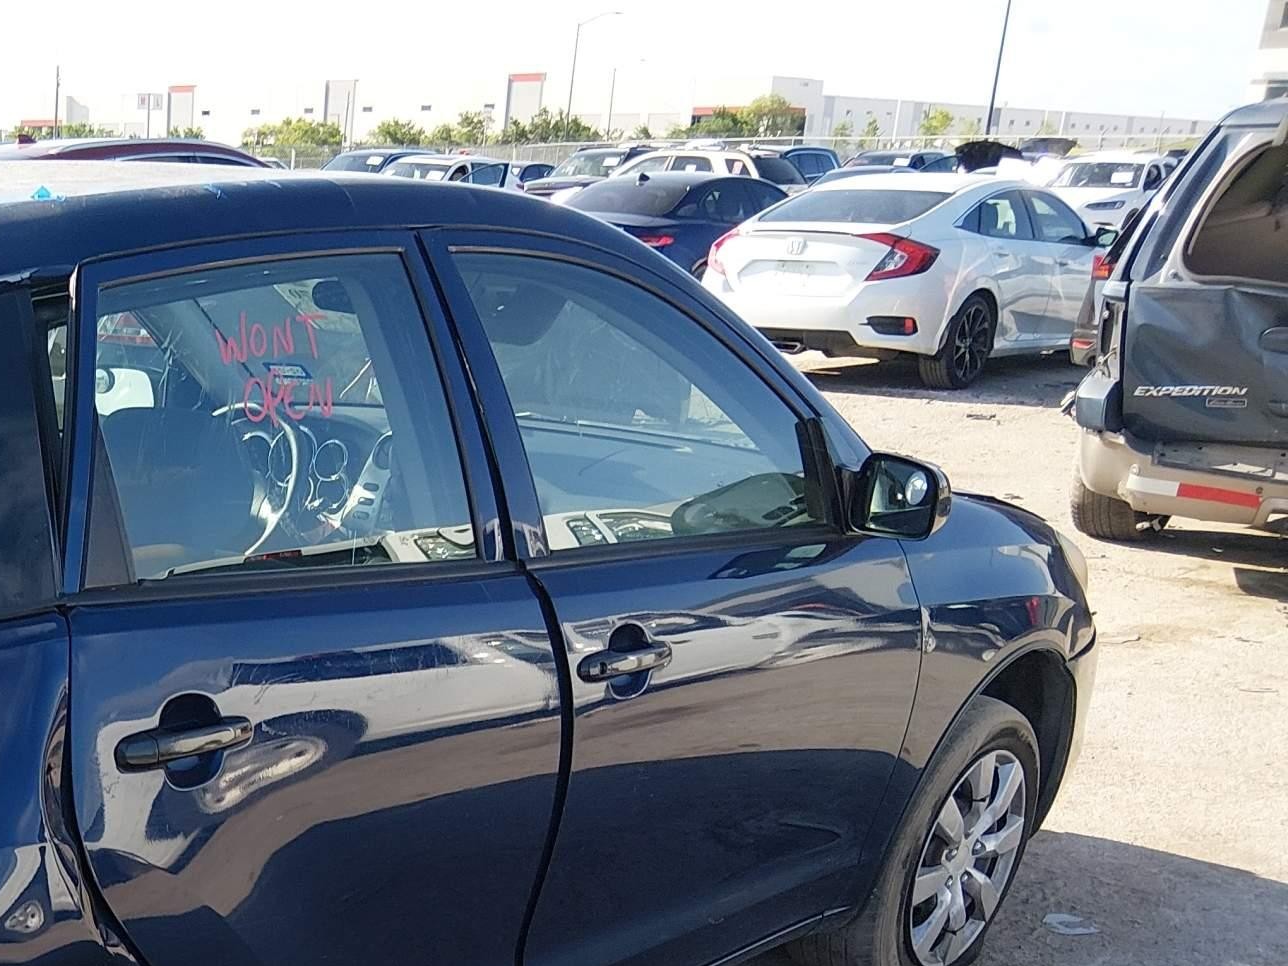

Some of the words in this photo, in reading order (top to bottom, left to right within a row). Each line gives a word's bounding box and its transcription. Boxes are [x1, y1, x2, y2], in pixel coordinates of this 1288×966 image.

[215, 309, 328, 366] WONT
[244, 367, 334, 429] OPEN
[1133, 385, 1249, 397] EXPEDITION
